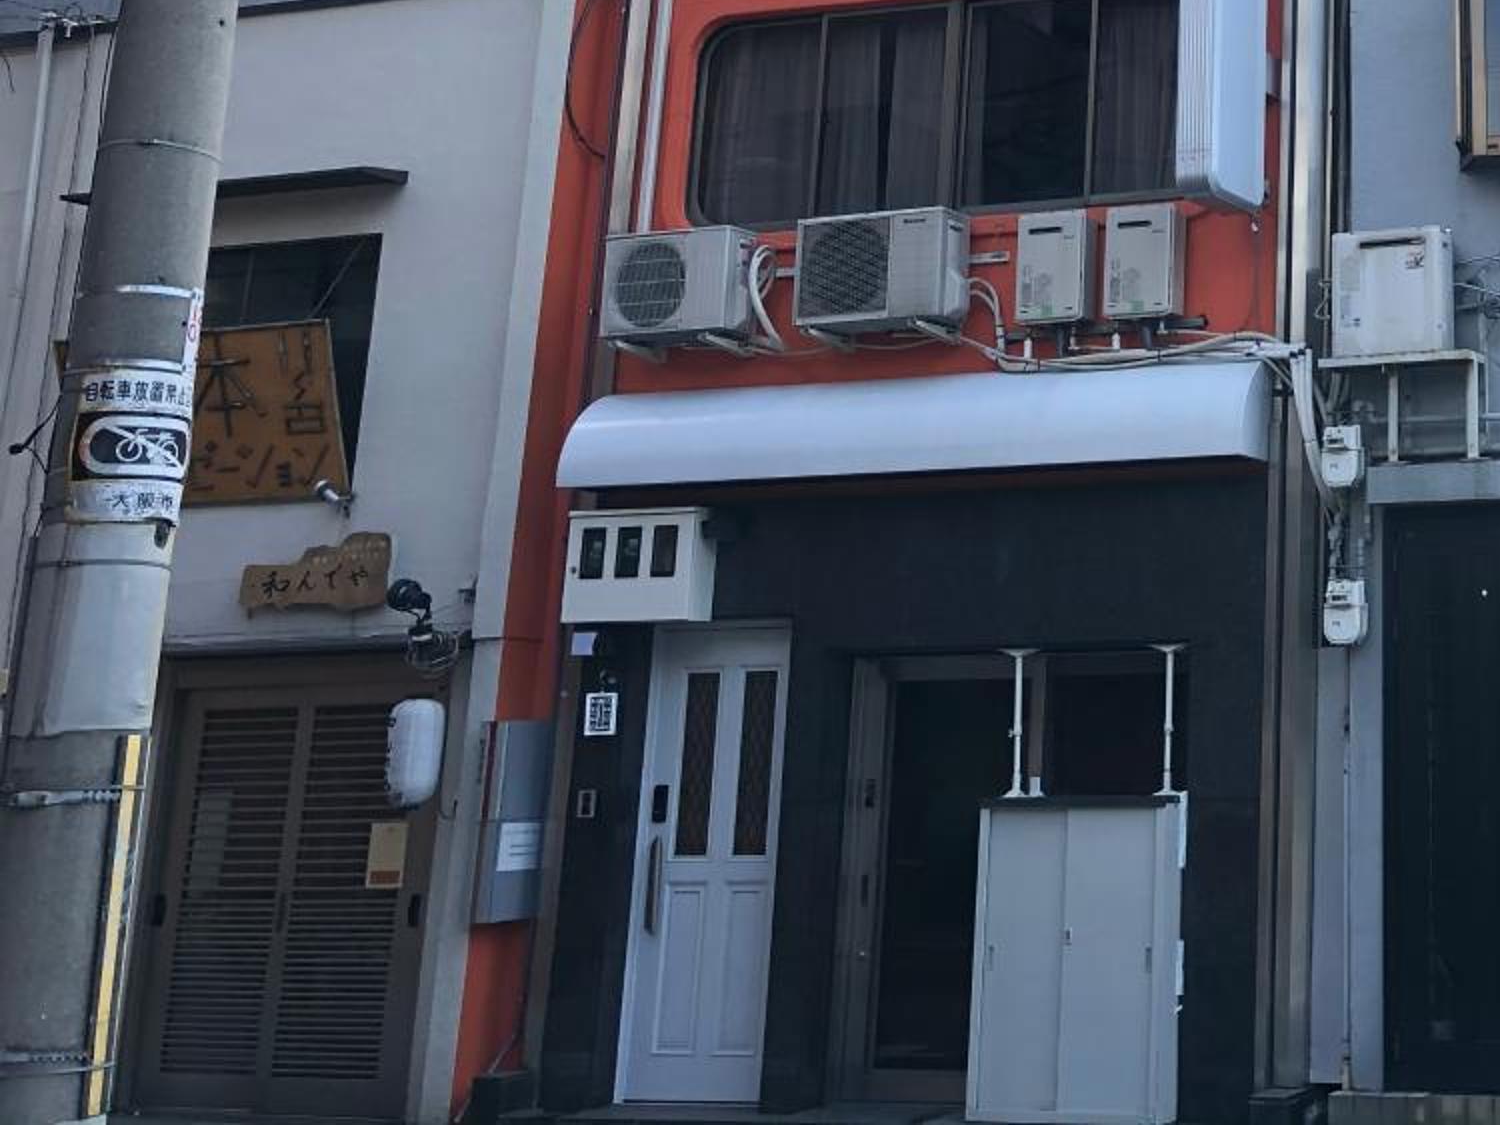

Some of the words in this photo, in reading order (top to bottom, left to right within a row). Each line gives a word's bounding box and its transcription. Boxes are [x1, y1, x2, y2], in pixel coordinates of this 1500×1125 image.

[86, 379, 191, 408] 自転車放置禁止
[111, 492, 175, 510] 大阪市
